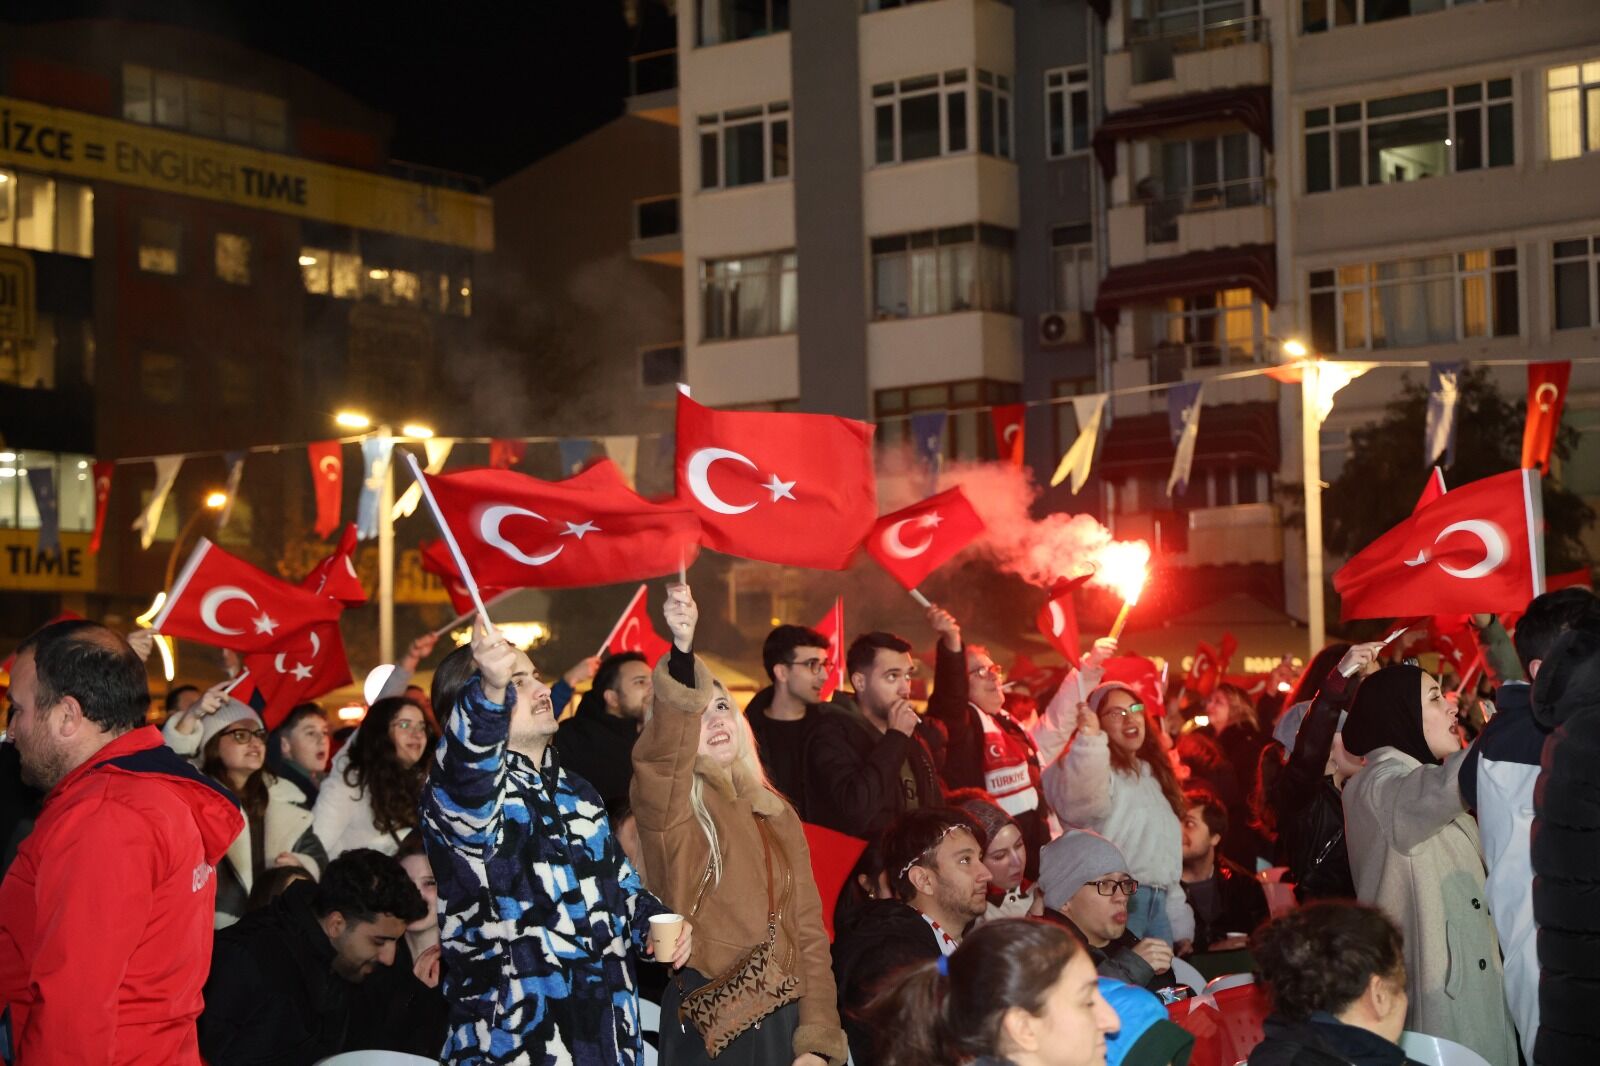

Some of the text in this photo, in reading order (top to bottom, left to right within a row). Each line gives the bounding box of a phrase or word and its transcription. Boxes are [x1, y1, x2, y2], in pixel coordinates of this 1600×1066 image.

[116, 141, 236, 194] ENGLISH
[240, 168, 308, 206] TIME
[6, 545, 81, 576] TIME
[991, 771, 1024, 789] TÜRKİYE
